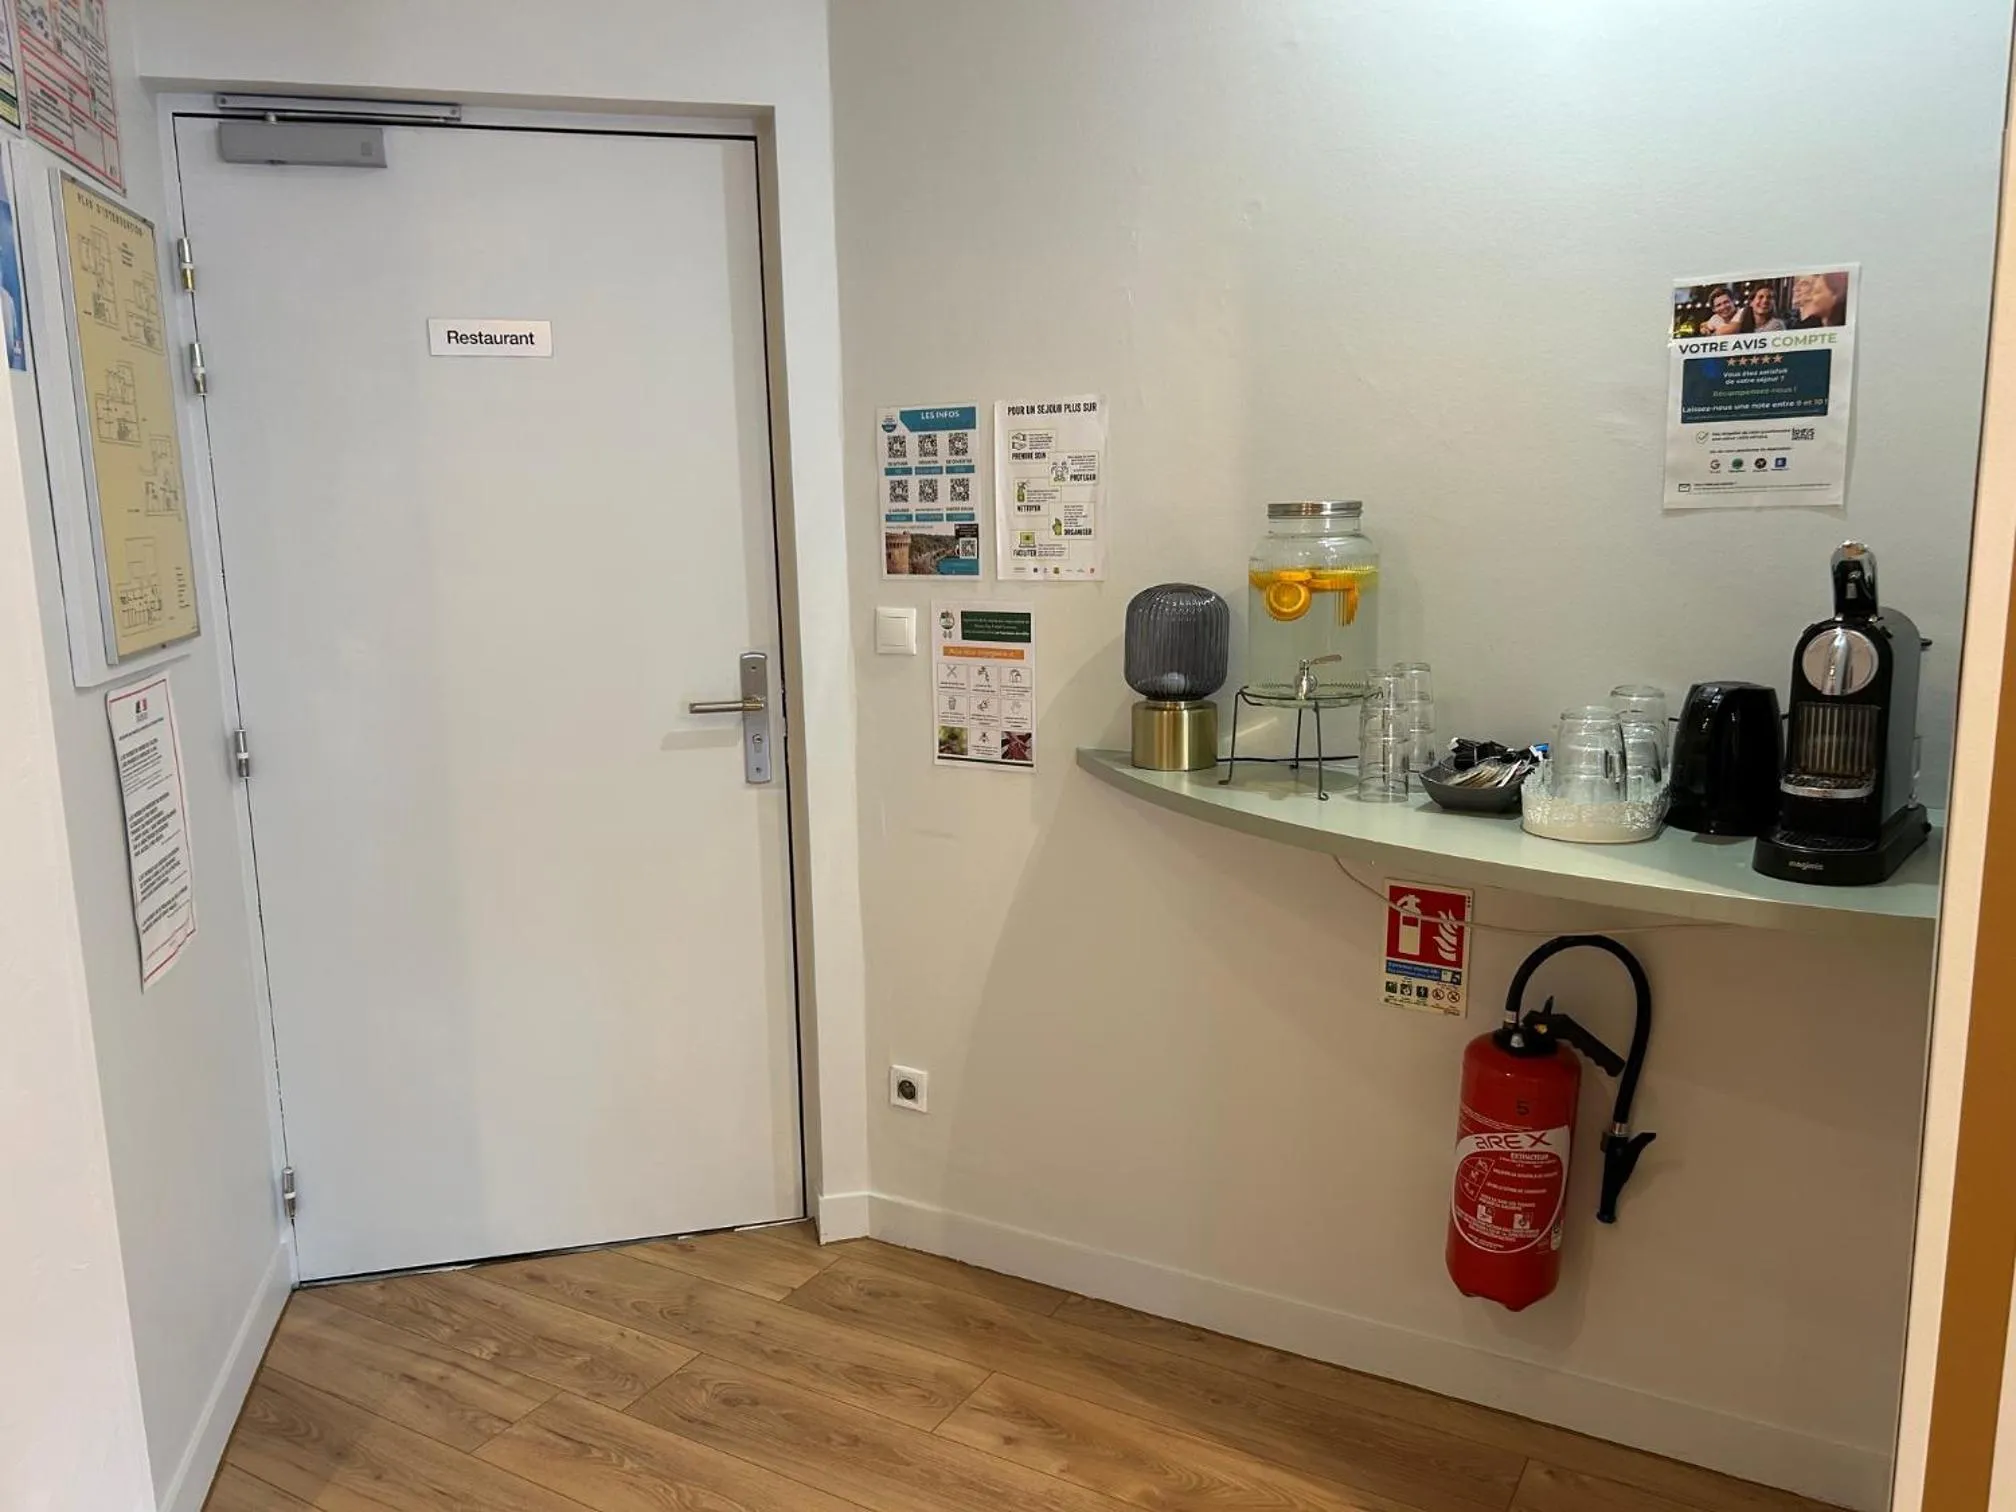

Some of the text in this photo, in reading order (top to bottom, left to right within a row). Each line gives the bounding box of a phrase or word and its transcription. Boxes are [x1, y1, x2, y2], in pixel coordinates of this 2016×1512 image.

[447, 330, 535, 345] Restaurant
[1679, 333, 1838, 355] VOTRE AVIS COMPTE
[1007, 406, 1025, 416] POUR
[1026, 405, 1035, 415] UN
[1064, 402, 1081, 413] PLUS
[1083, 402, 1097, 412] SUR
[1683, 404, 1732, 413] Laissez-nous
[1752, 402, 1771, 410] note
[1772, 400, 1795, 408] entre
[921, 410, 960, 420] LES INFOS
[1012, 452, 1046, 460] PRENDRE SOIN
[1517, 1101, 1529, 1116] 5
